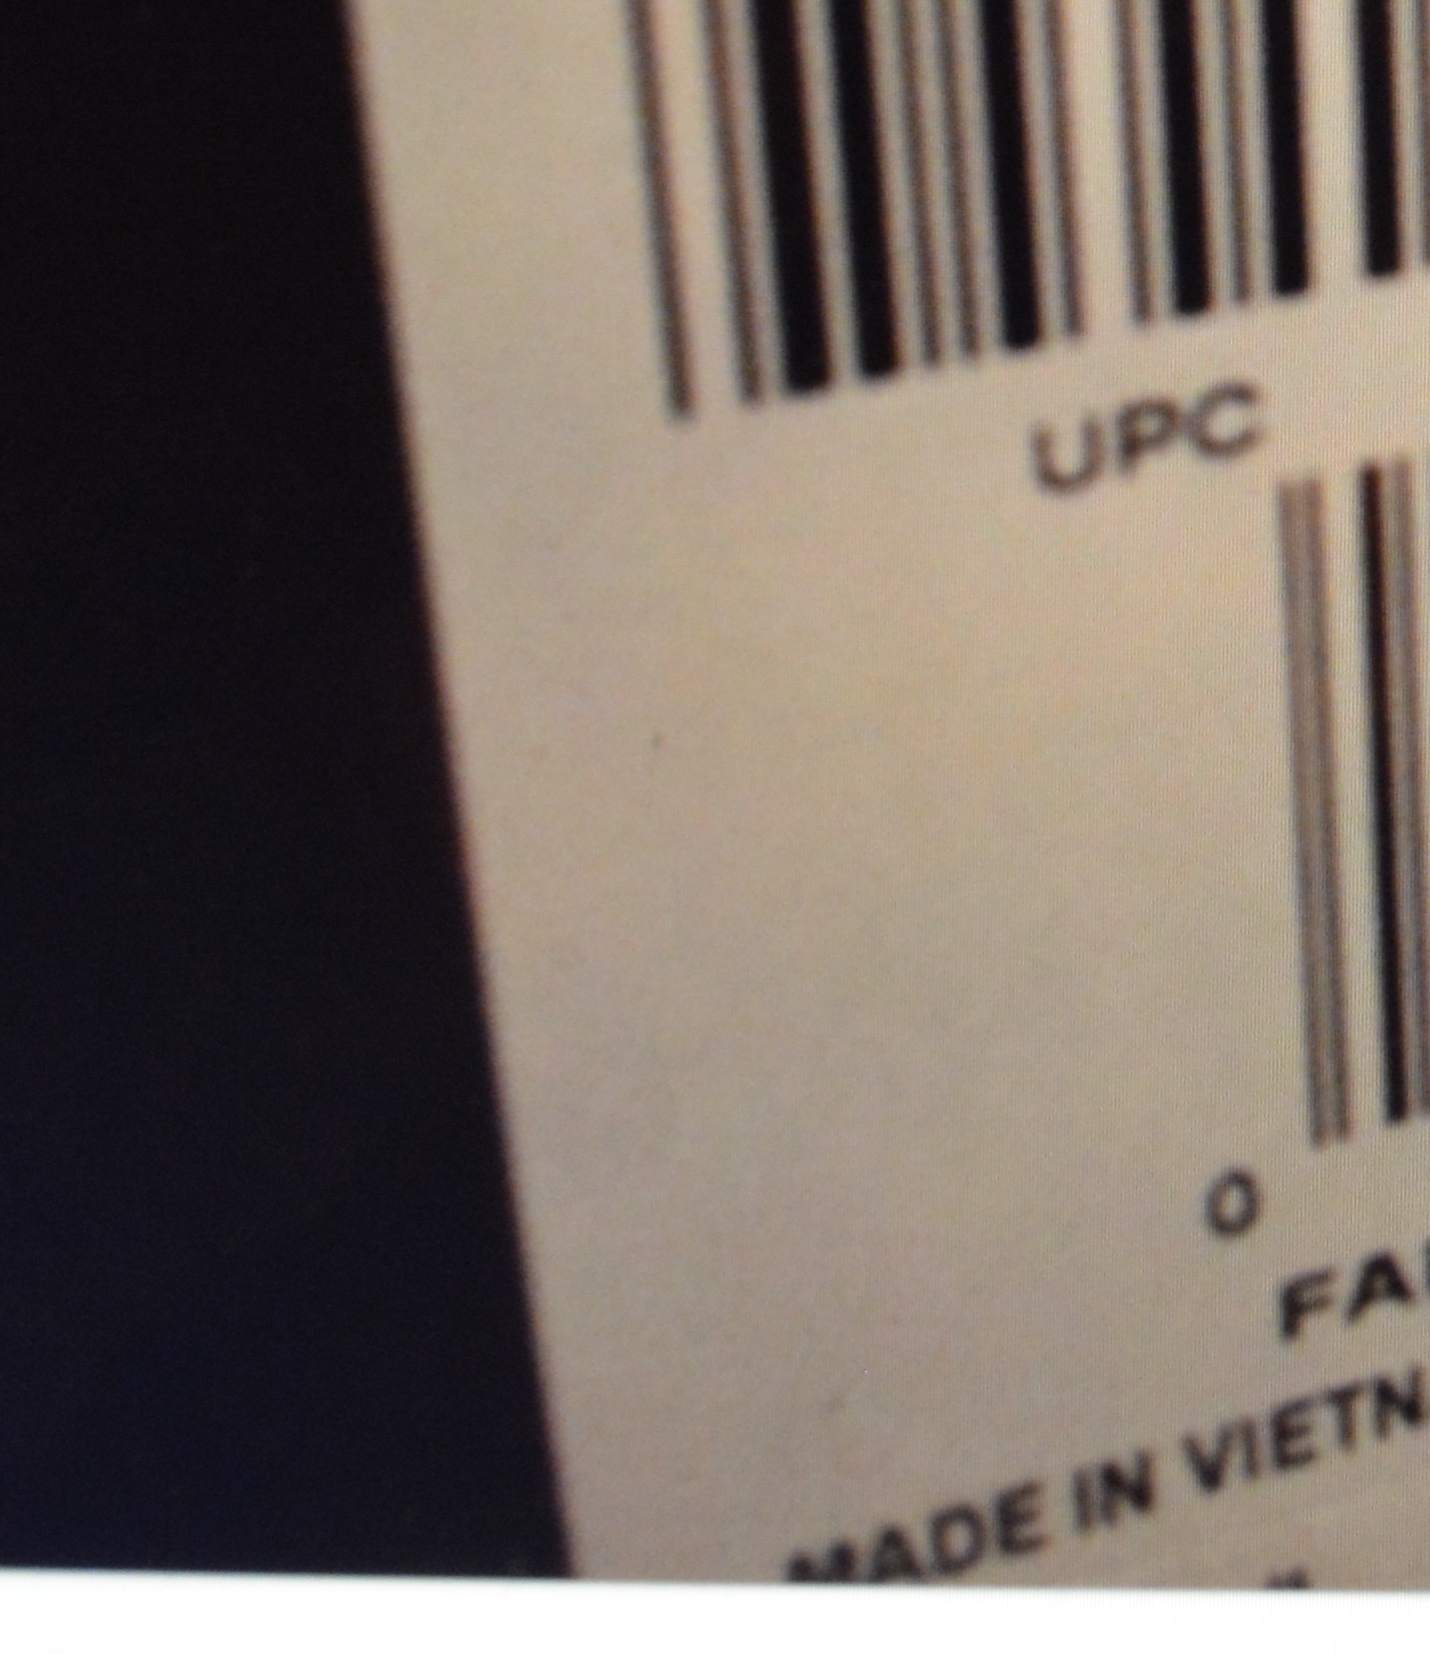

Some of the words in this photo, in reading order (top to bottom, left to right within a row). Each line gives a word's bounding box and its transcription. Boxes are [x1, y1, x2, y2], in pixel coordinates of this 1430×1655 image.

[1029, 379, 1264, 498] UPC
[1205, 1169, 1262, 1238] 0
[1073, 1448, 1154, 1531] IN
